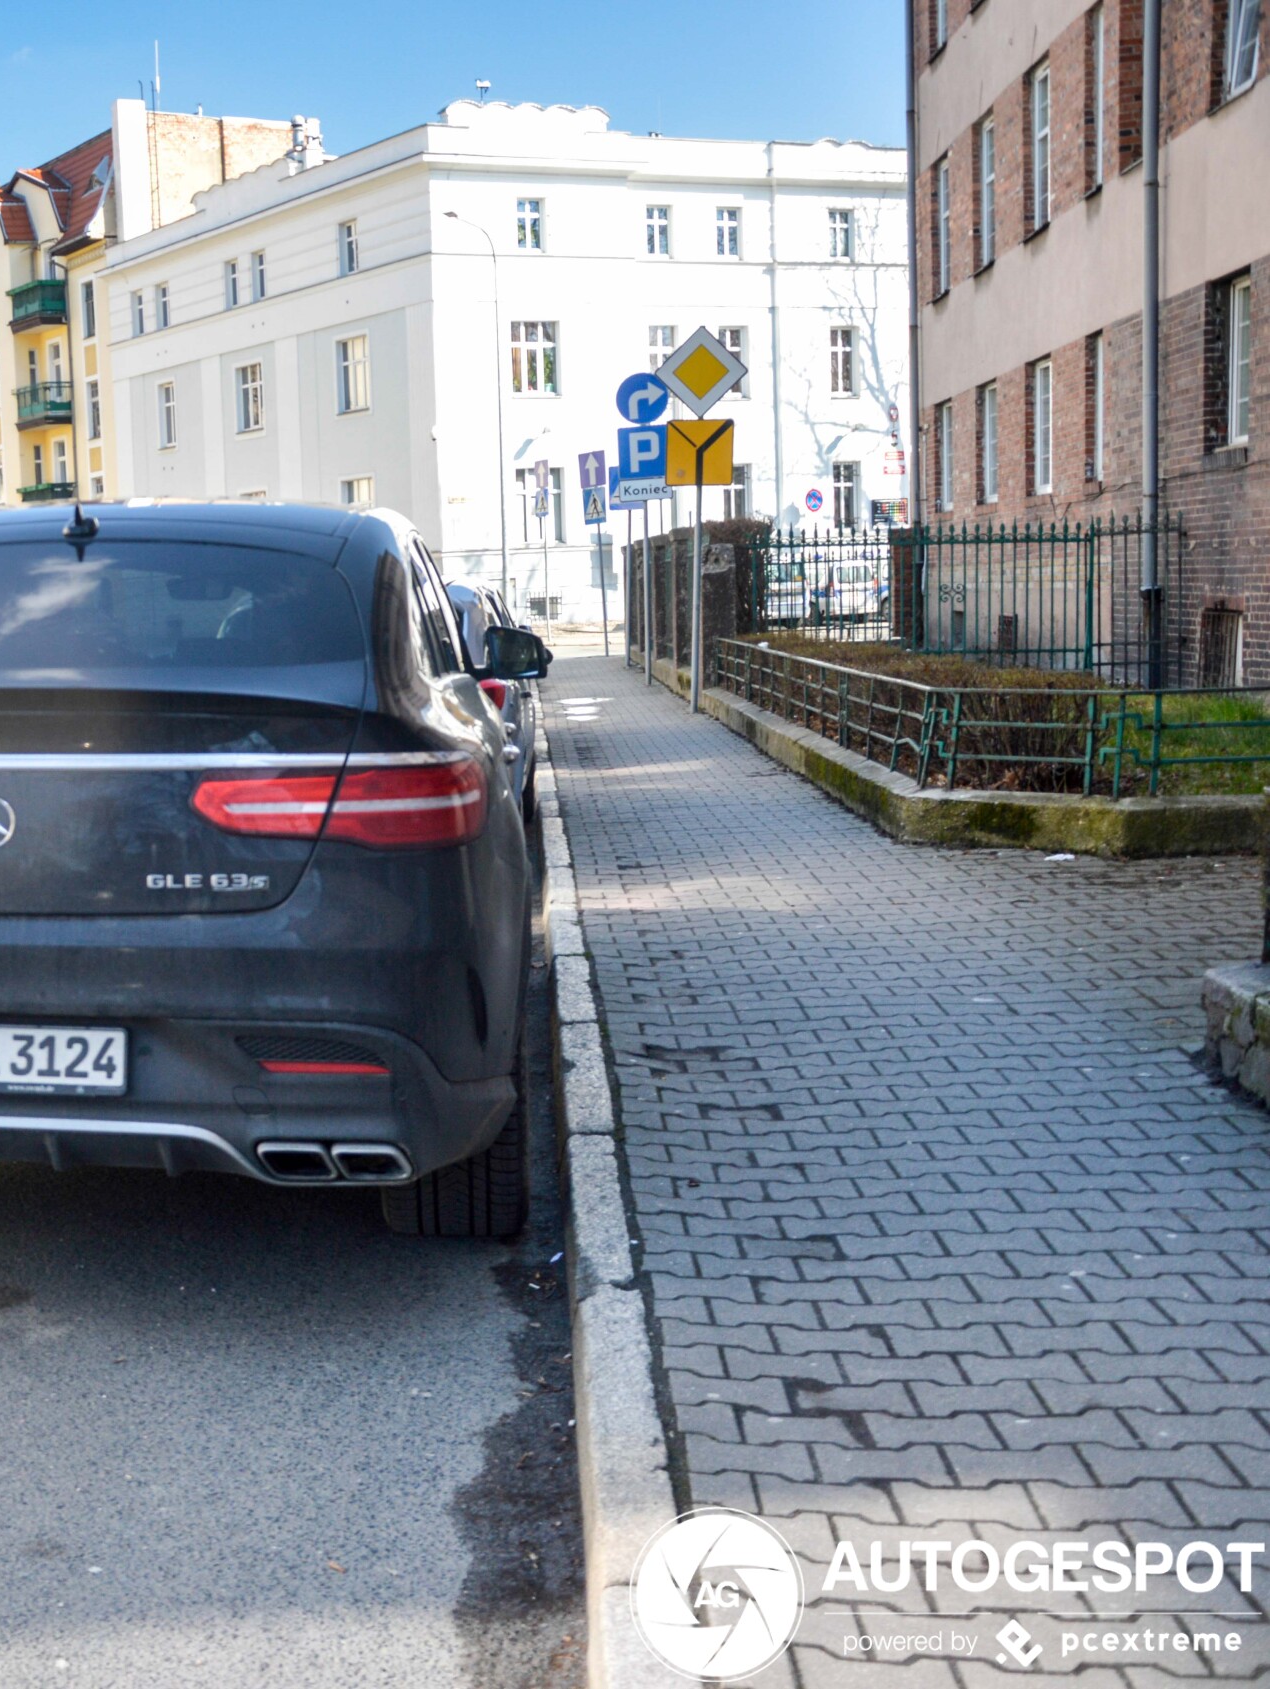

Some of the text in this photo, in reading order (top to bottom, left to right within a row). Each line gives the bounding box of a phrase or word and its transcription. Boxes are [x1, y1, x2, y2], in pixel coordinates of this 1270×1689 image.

[629, 431, 660, 473] P
[623, 484, 668, 496] Koniec
[146, 873, 203, 889] GLE
